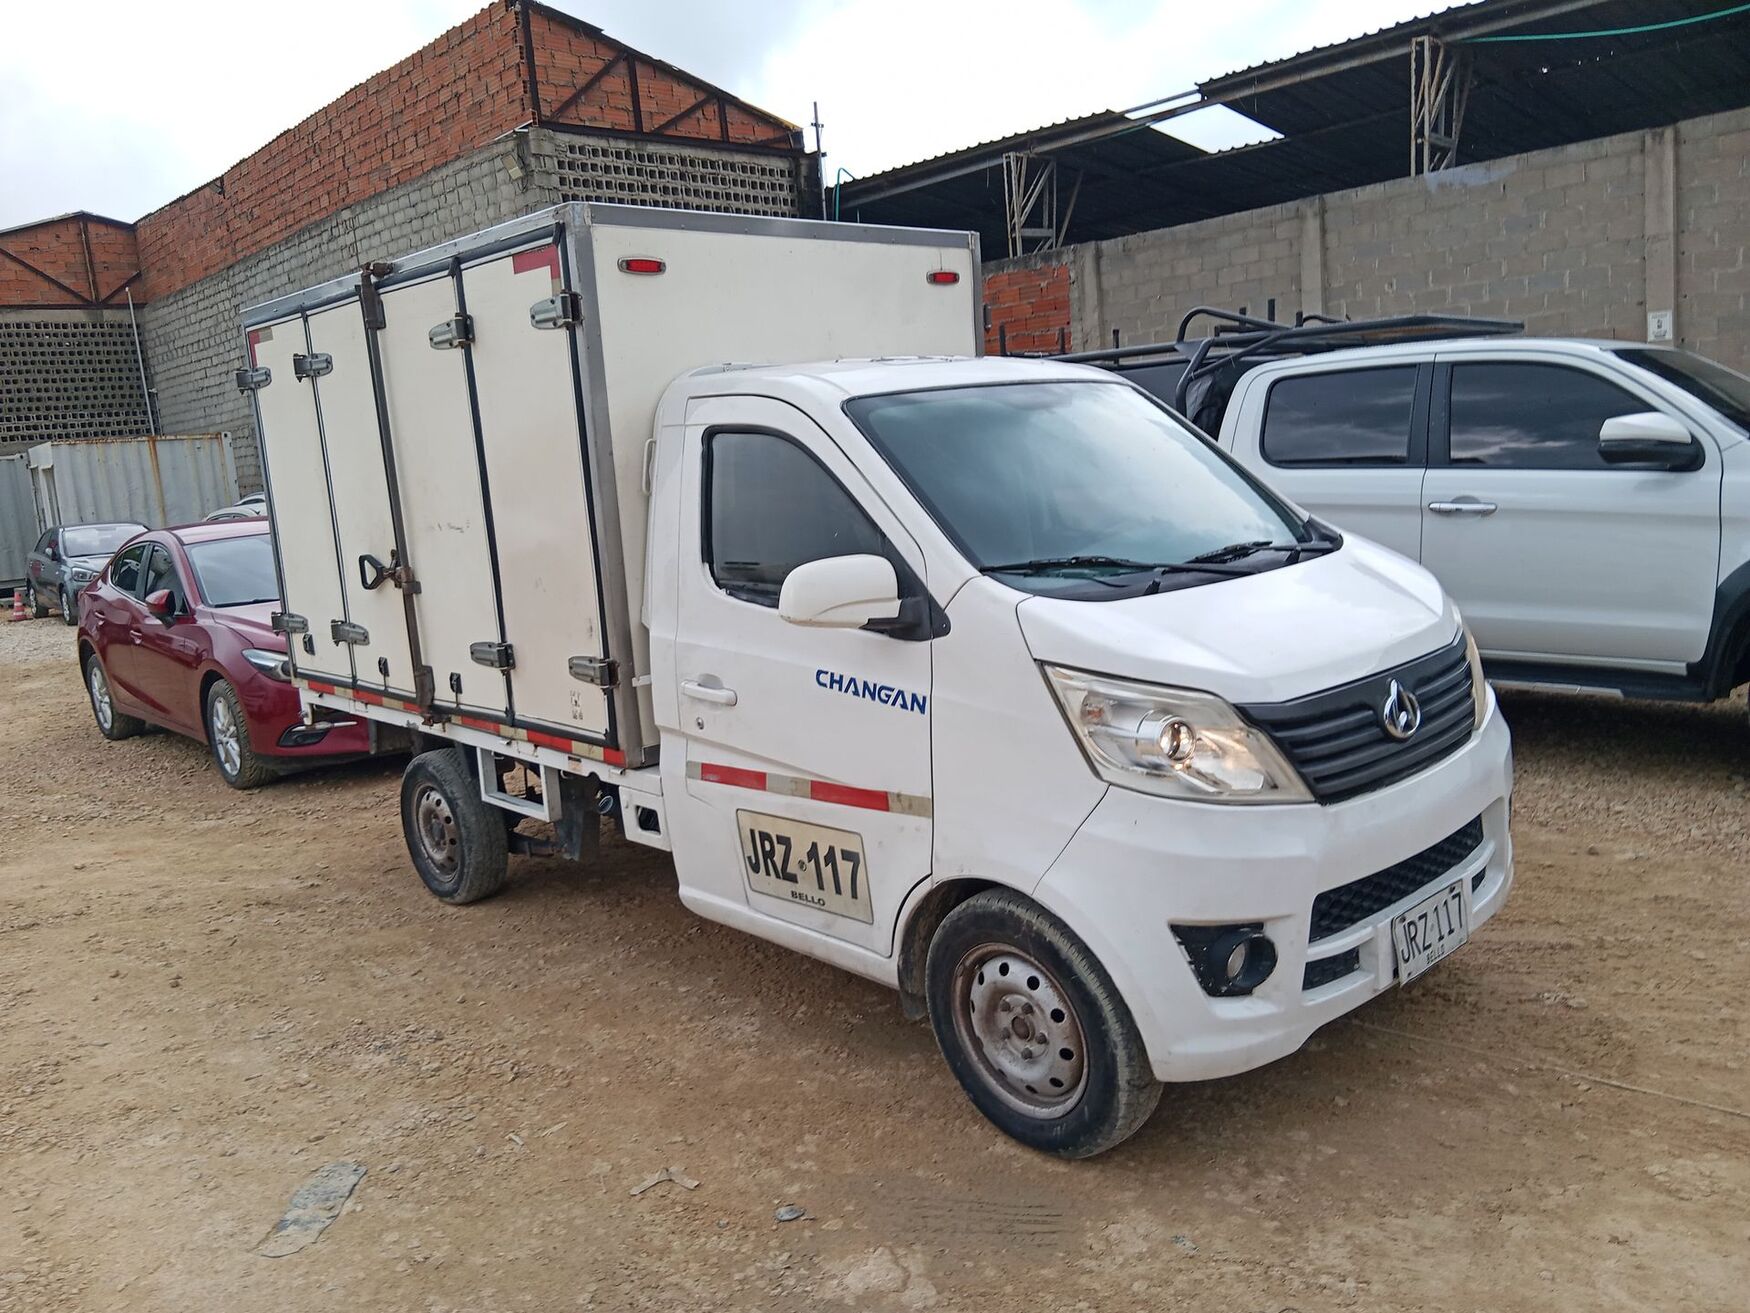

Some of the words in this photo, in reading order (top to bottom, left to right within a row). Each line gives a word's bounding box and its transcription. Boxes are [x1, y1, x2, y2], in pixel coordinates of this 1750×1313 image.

[816, 669, 927, 715] CHANGAN
[747, 829, 799, 884] JRZ
[806, 841, 861, 900] 117
[791, 890, 826, 907] BELLO
[1401, 912, 1432, 964] JRZ
[1433, 891, 1463, 942] 117
